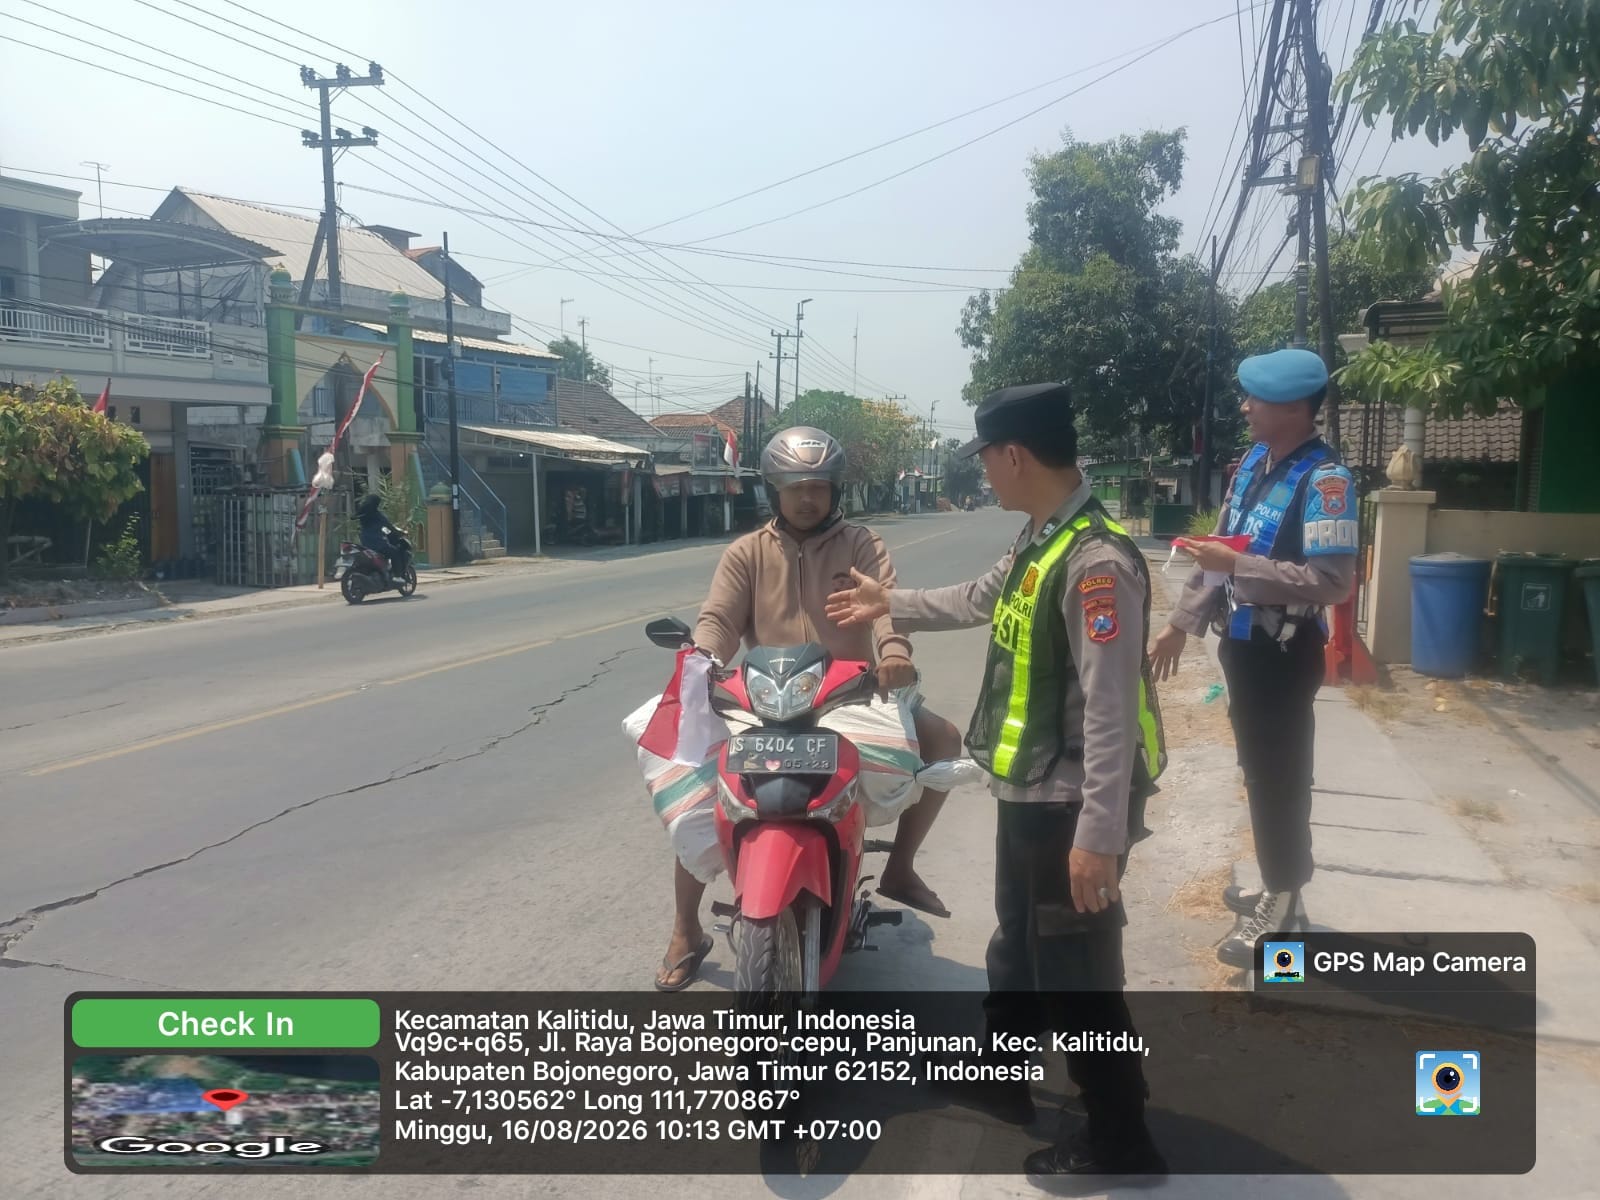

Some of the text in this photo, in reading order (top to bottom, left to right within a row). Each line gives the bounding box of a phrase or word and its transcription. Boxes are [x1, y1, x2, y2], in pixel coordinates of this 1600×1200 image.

[1254, 503, 1282, 521] POLRI
[1010, 594, 1032, 618] POLRI
[735, 737, 827, 753] S 6404 CF
